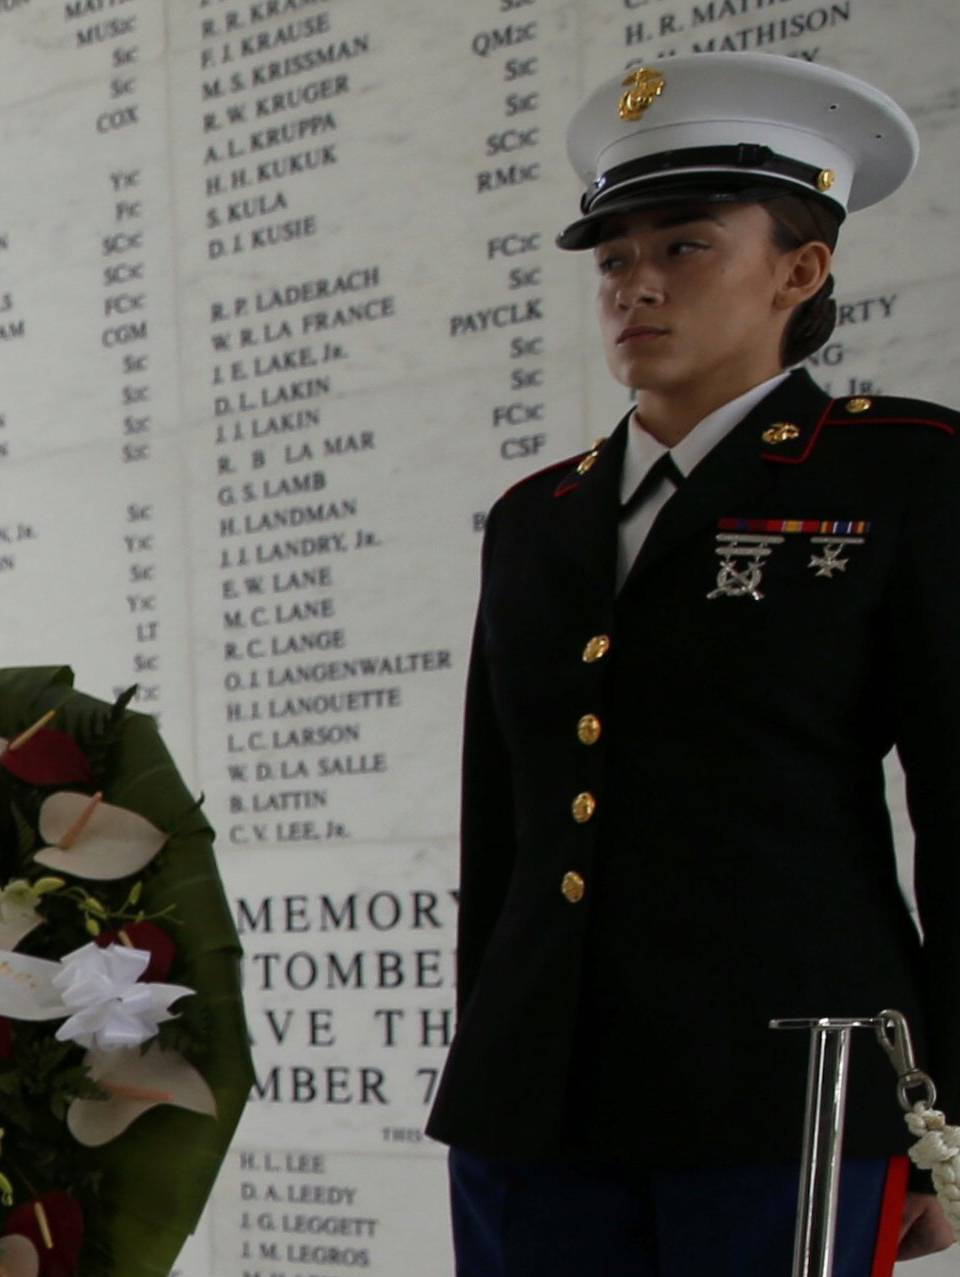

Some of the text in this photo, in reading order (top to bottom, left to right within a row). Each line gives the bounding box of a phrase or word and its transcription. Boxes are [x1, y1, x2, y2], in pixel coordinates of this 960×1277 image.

[241, 13, 329, 56] KRAUSE
[692, 1, 851, 53] MATHISON
[252, 36, 368, 85] KRISSMAN
[256, 75, 349, 117] KRUGER
[251, 113, 336, 151] KRUPPA
[257, 145, 336, 181] KUKUK
[228, 192, 287, 222] KULA
[252, 216, 315, 248] KUSIE
[256, 267, 379, 312] LADERACH
[302, 297, 394, 333] FRANCE
[450, 299, 543, 336] PAYCLK
[262, 378, 330, 407] LAKIN
[252, 410, 320, 438] LAKIN
[324, 431, 374, 454] MAR
[501, 434, 545, 459] CSF
[264, 471, 326, 498] LAMB
[245, 500, 356, 533] LANDMAN
[273, 567, 331, 593] LANE
[276, 598, 334, 624] LANE
[272, 629, 344, 656] LANGE
[268, 650, 451, 686] LANGENWALTER
[269, 687, 400, 718] LANOUETTE
[273, 725, 359, 749] LARSON
[318, 753, 387, 776] SALLE
[253, 790, 327, 812] LATTIN
[286, 1153, 324, 1174] LEE
[288, 1184, 356, 1205] LEEDY
[282, 1215, 377, 1237] LEGGETT
